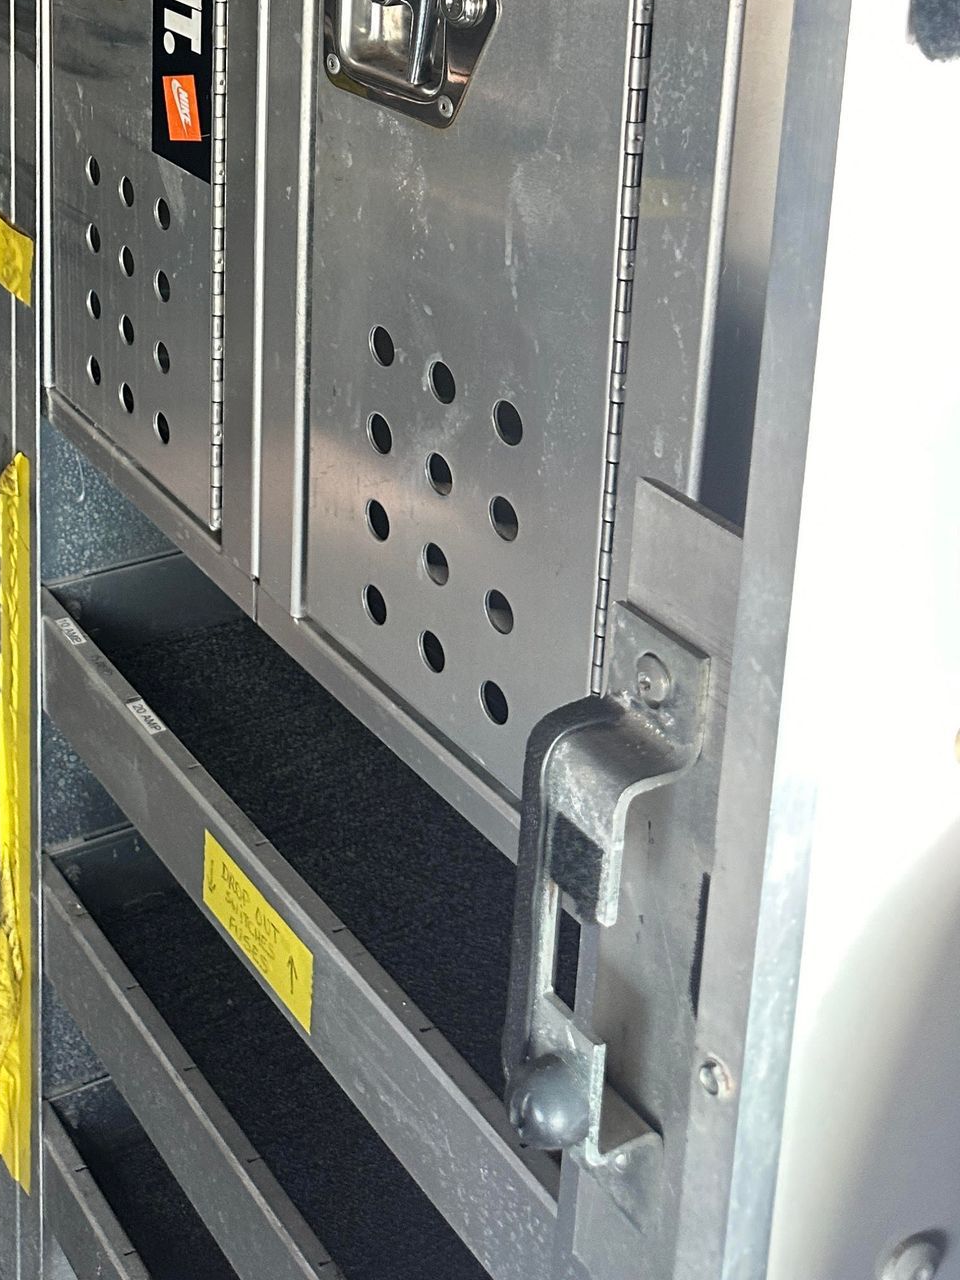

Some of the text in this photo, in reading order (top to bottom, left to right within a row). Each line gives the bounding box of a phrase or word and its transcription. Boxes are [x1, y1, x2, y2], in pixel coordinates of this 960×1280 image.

[63, 628, 82, 644] AMP
[133, 703, 162, 733] 20 AMP
[221, 861, 280, 944] DROP OUT
[225, 890, 276, 961] SWITCHES
[228, 915, 269, 974] FUSES
